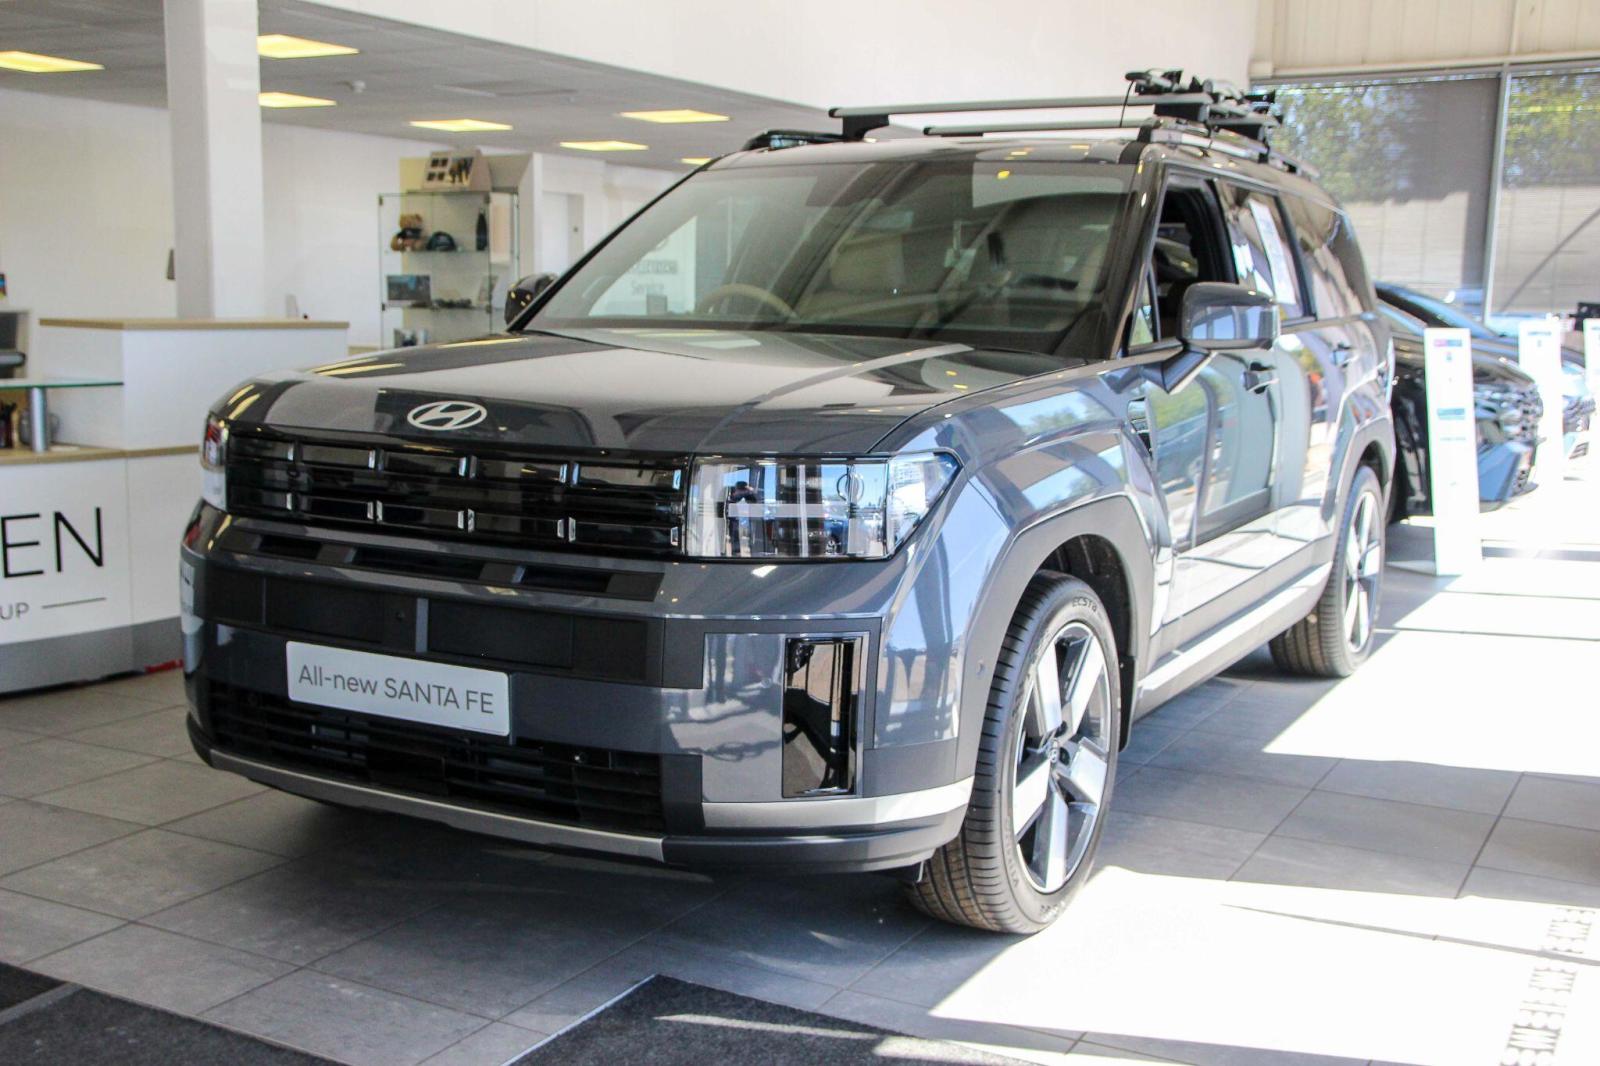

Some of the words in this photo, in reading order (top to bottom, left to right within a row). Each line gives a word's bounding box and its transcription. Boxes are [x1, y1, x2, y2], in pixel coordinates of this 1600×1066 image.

[1, 507, 104, 578] EN
[0, 602, 30, 620] UP
[298, 664, 378, 695] All-new
[384, 677, 460, 709] SANTA
[466, 690, 494, 714] FE
